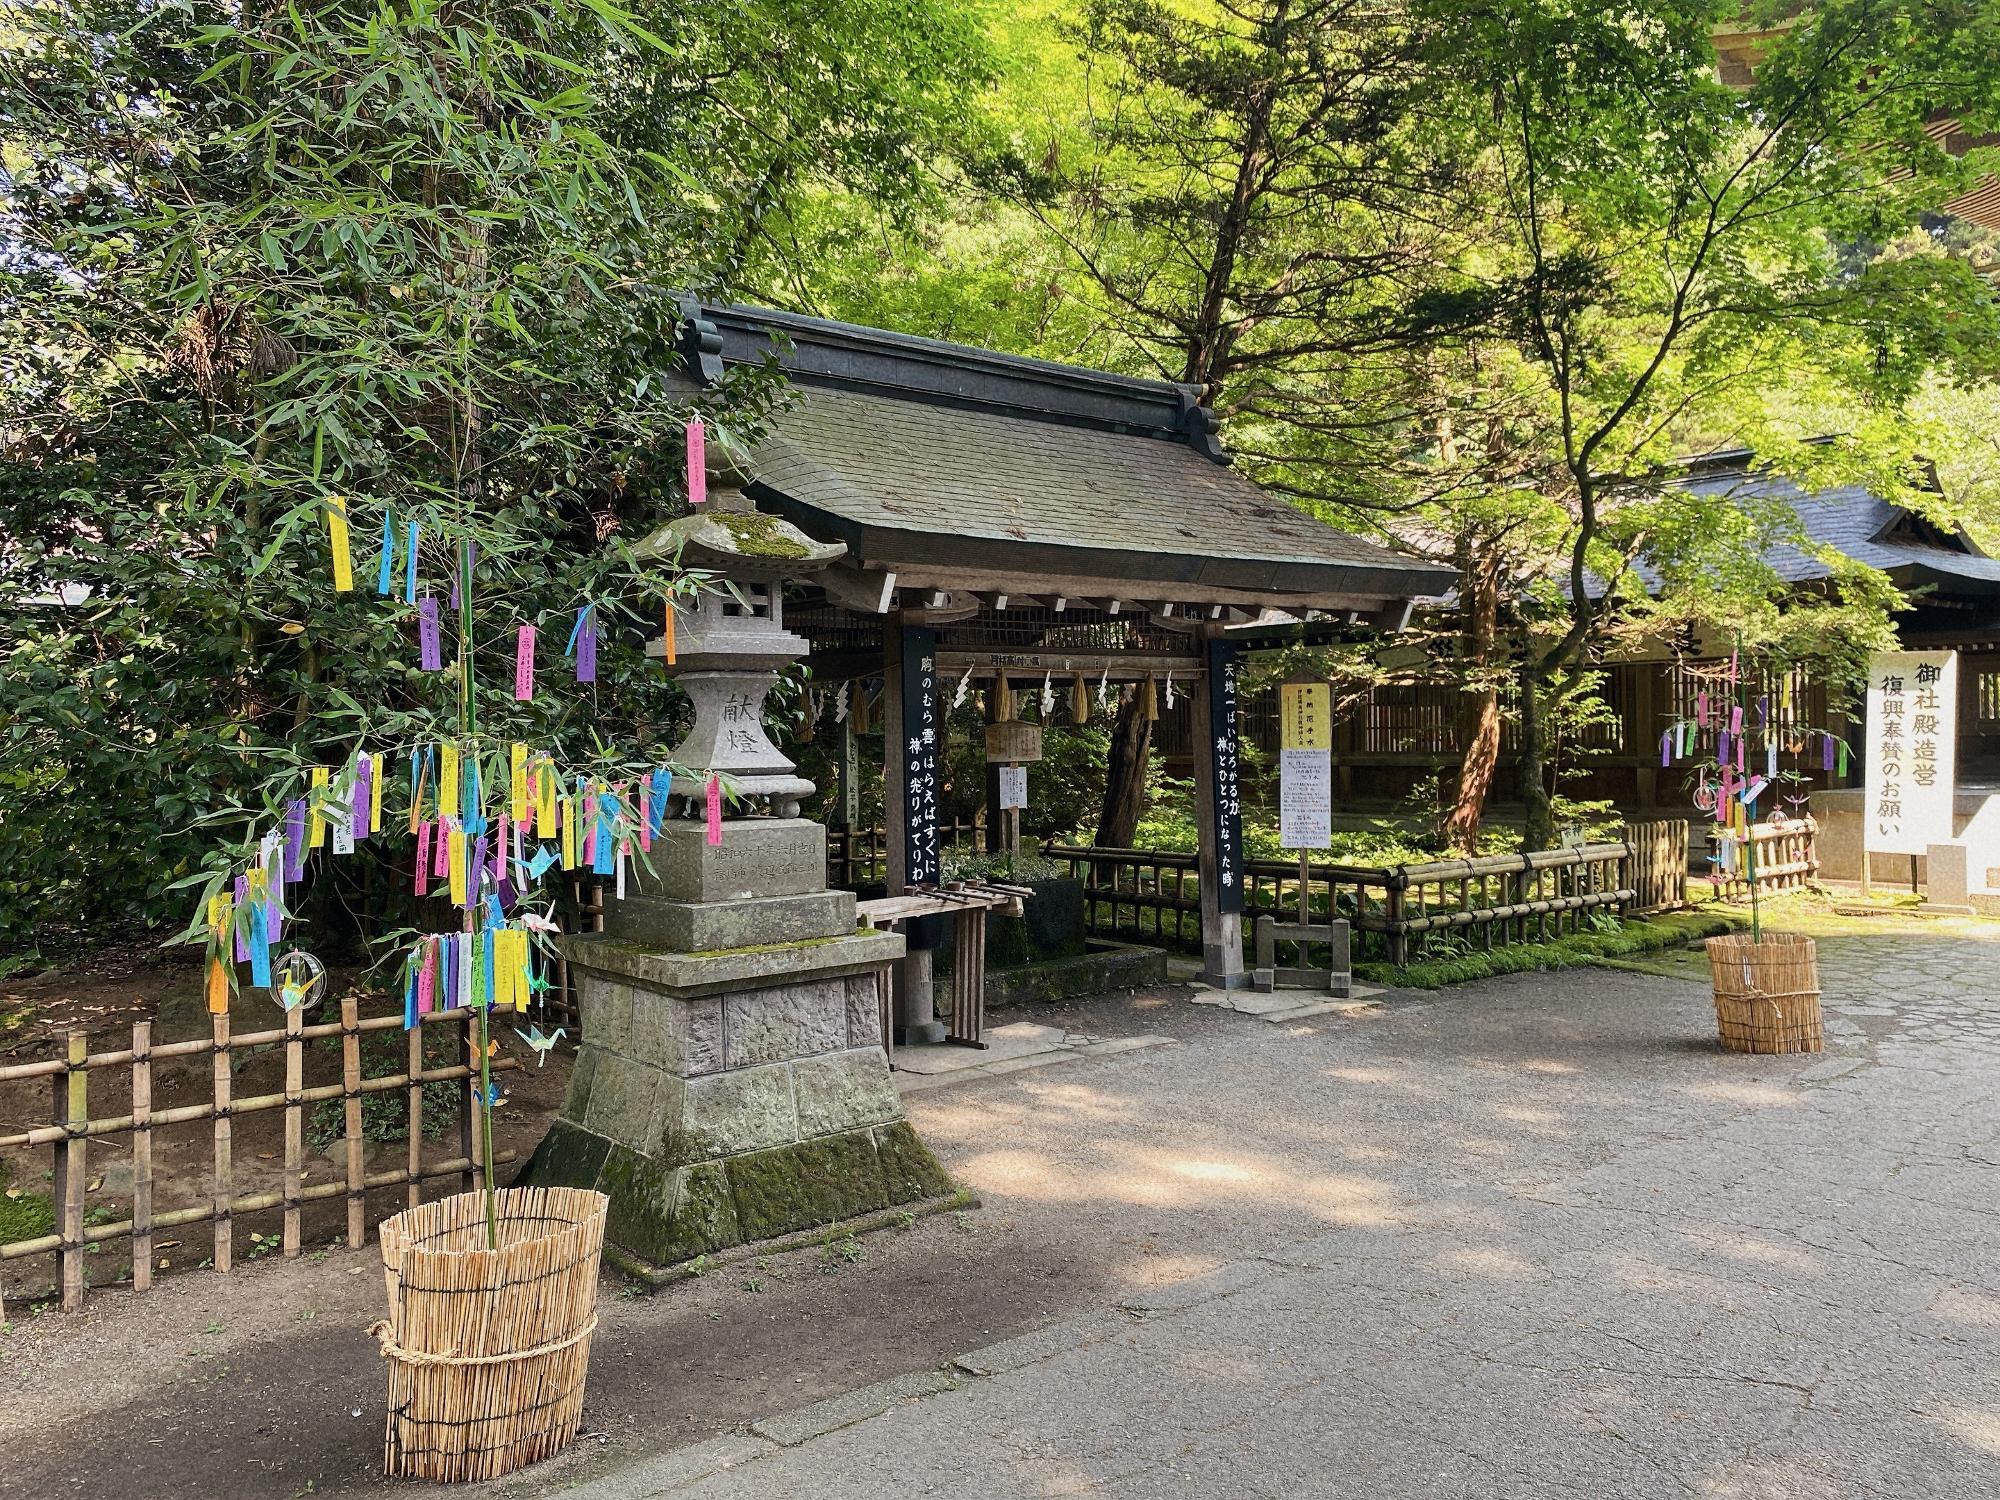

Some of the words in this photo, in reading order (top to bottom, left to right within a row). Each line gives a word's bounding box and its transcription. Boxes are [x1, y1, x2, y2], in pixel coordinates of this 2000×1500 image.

[723, 694, 759, 754] 献燈
[1877, 675, 1905, 836] 復興奉賛のお願い
[1911, 662, 1941, 786] 御社殿造営
[908, 737, 923, 886] 神の光りがてりわ
[1217, 736, 1232, 888] 神とひとつになった時
